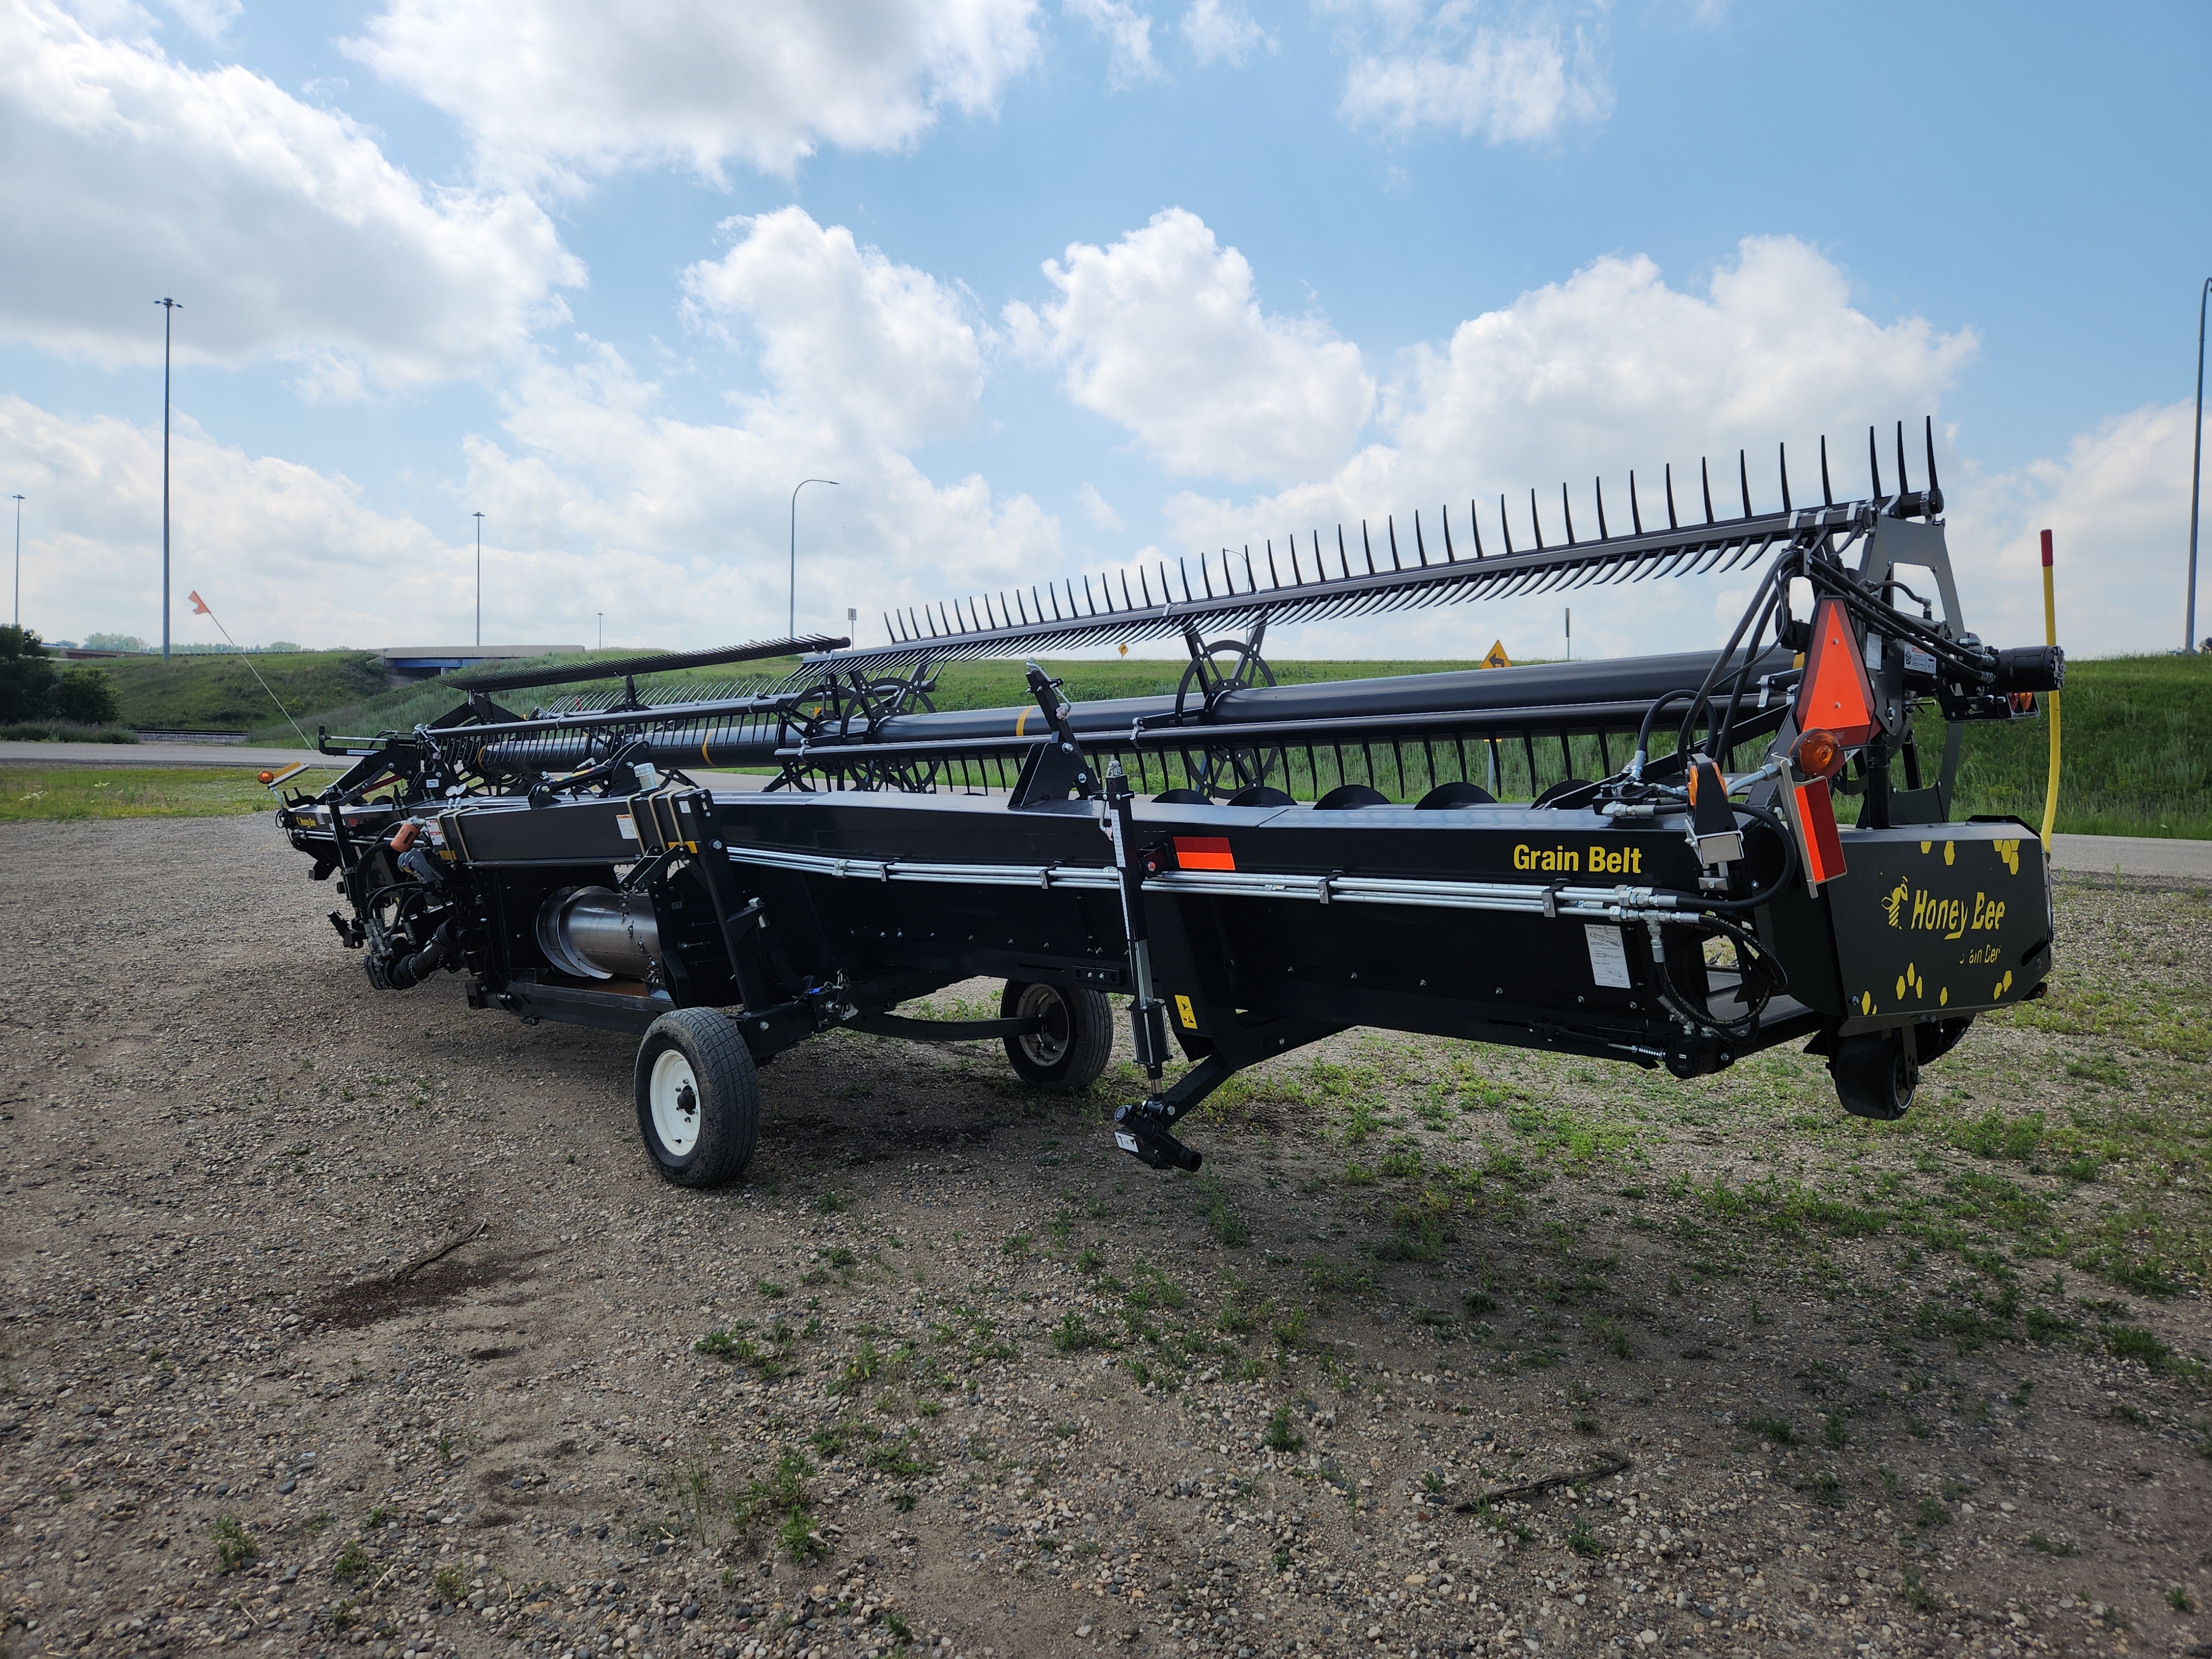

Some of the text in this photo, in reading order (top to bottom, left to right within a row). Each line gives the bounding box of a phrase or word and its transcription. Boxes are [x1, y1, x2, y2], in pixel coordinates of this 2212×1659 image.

[1514, 844, 1642, 874] Grain Belt
[1910, 889, 2006, 940] Honey Bee
